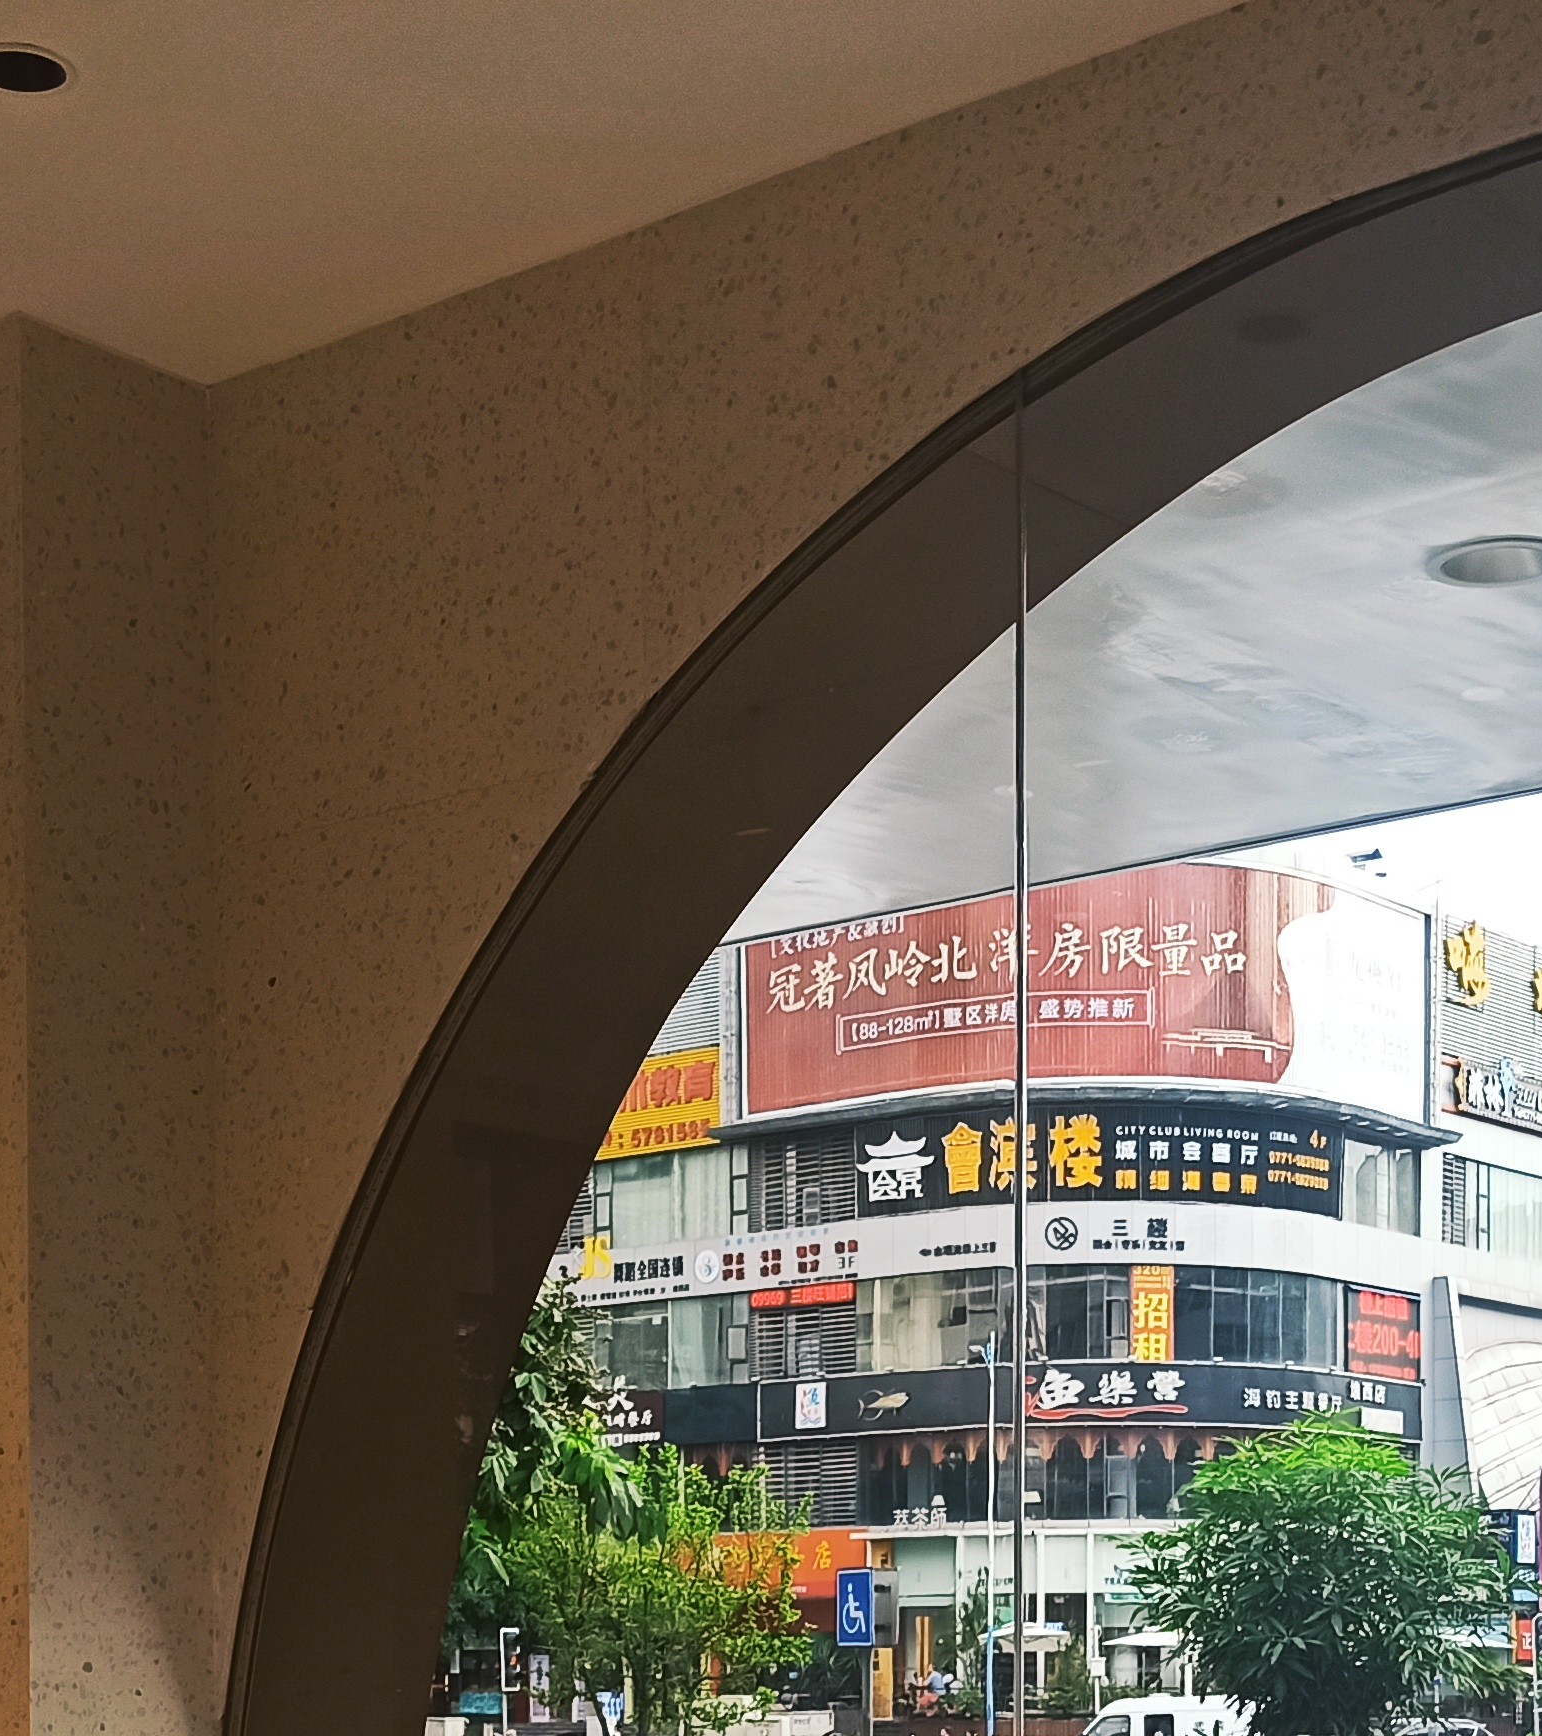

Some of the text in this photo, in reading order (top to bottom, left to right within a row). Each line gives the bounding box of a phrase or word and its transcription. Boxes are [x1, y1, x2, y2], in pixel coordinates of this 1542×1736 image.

[1115, 1125, 1259, 1141] CITY CLUB LIVING ROOM
[1132, 1291, 1169, 1361] 招租
